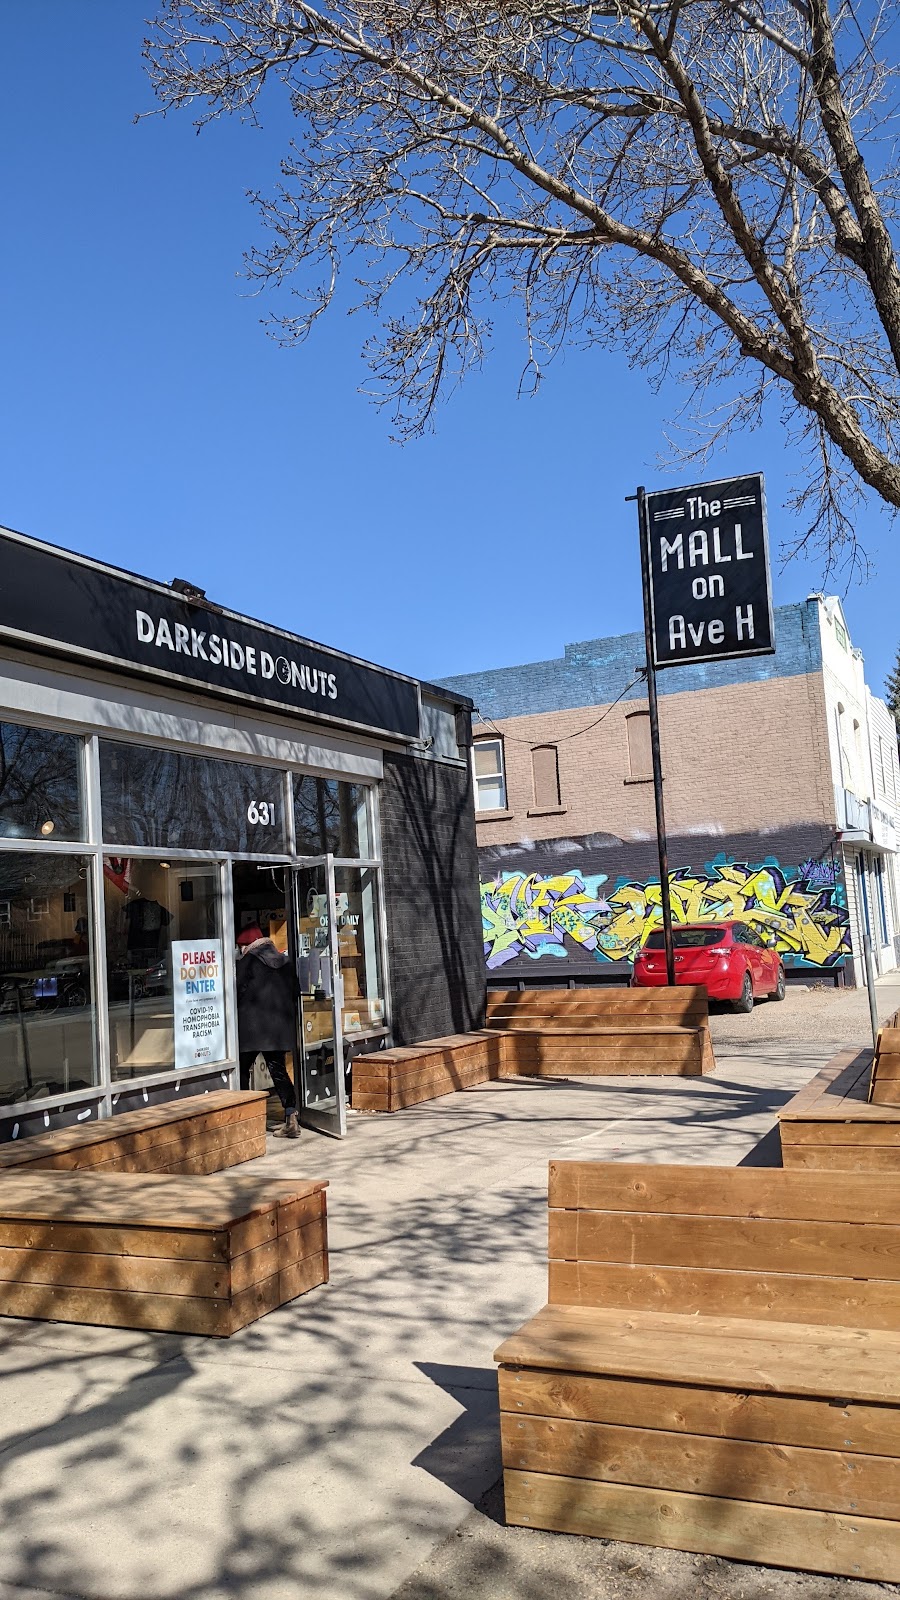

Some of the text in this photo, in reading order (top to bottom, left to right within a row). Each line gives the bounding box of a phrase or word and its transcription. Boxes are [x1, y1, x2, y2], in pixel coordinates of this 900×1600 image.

[687, 497, 721, 520] The
[660, 524, 754, 572] MALL
[692, 574, 725, 600] on
[668, 604, 755, 650] Ave H
[135, 609, 338, 700] DARKSIDE DONUTS
[247, 800, 275, 826] 631
[182, 951, 216, 965] PLEASE
[180, 965, 218, 980] DO NOT
[186, 979, 215, 994] ENTER
[190, 1005, 213, 1015] COVID-19
[183, 1013, 219, 1024] HOMOPHOBIA
[183, 1020, 219, 1031] TRANSPHOBIA
[193, 1029, 212, 1038] RACISM
